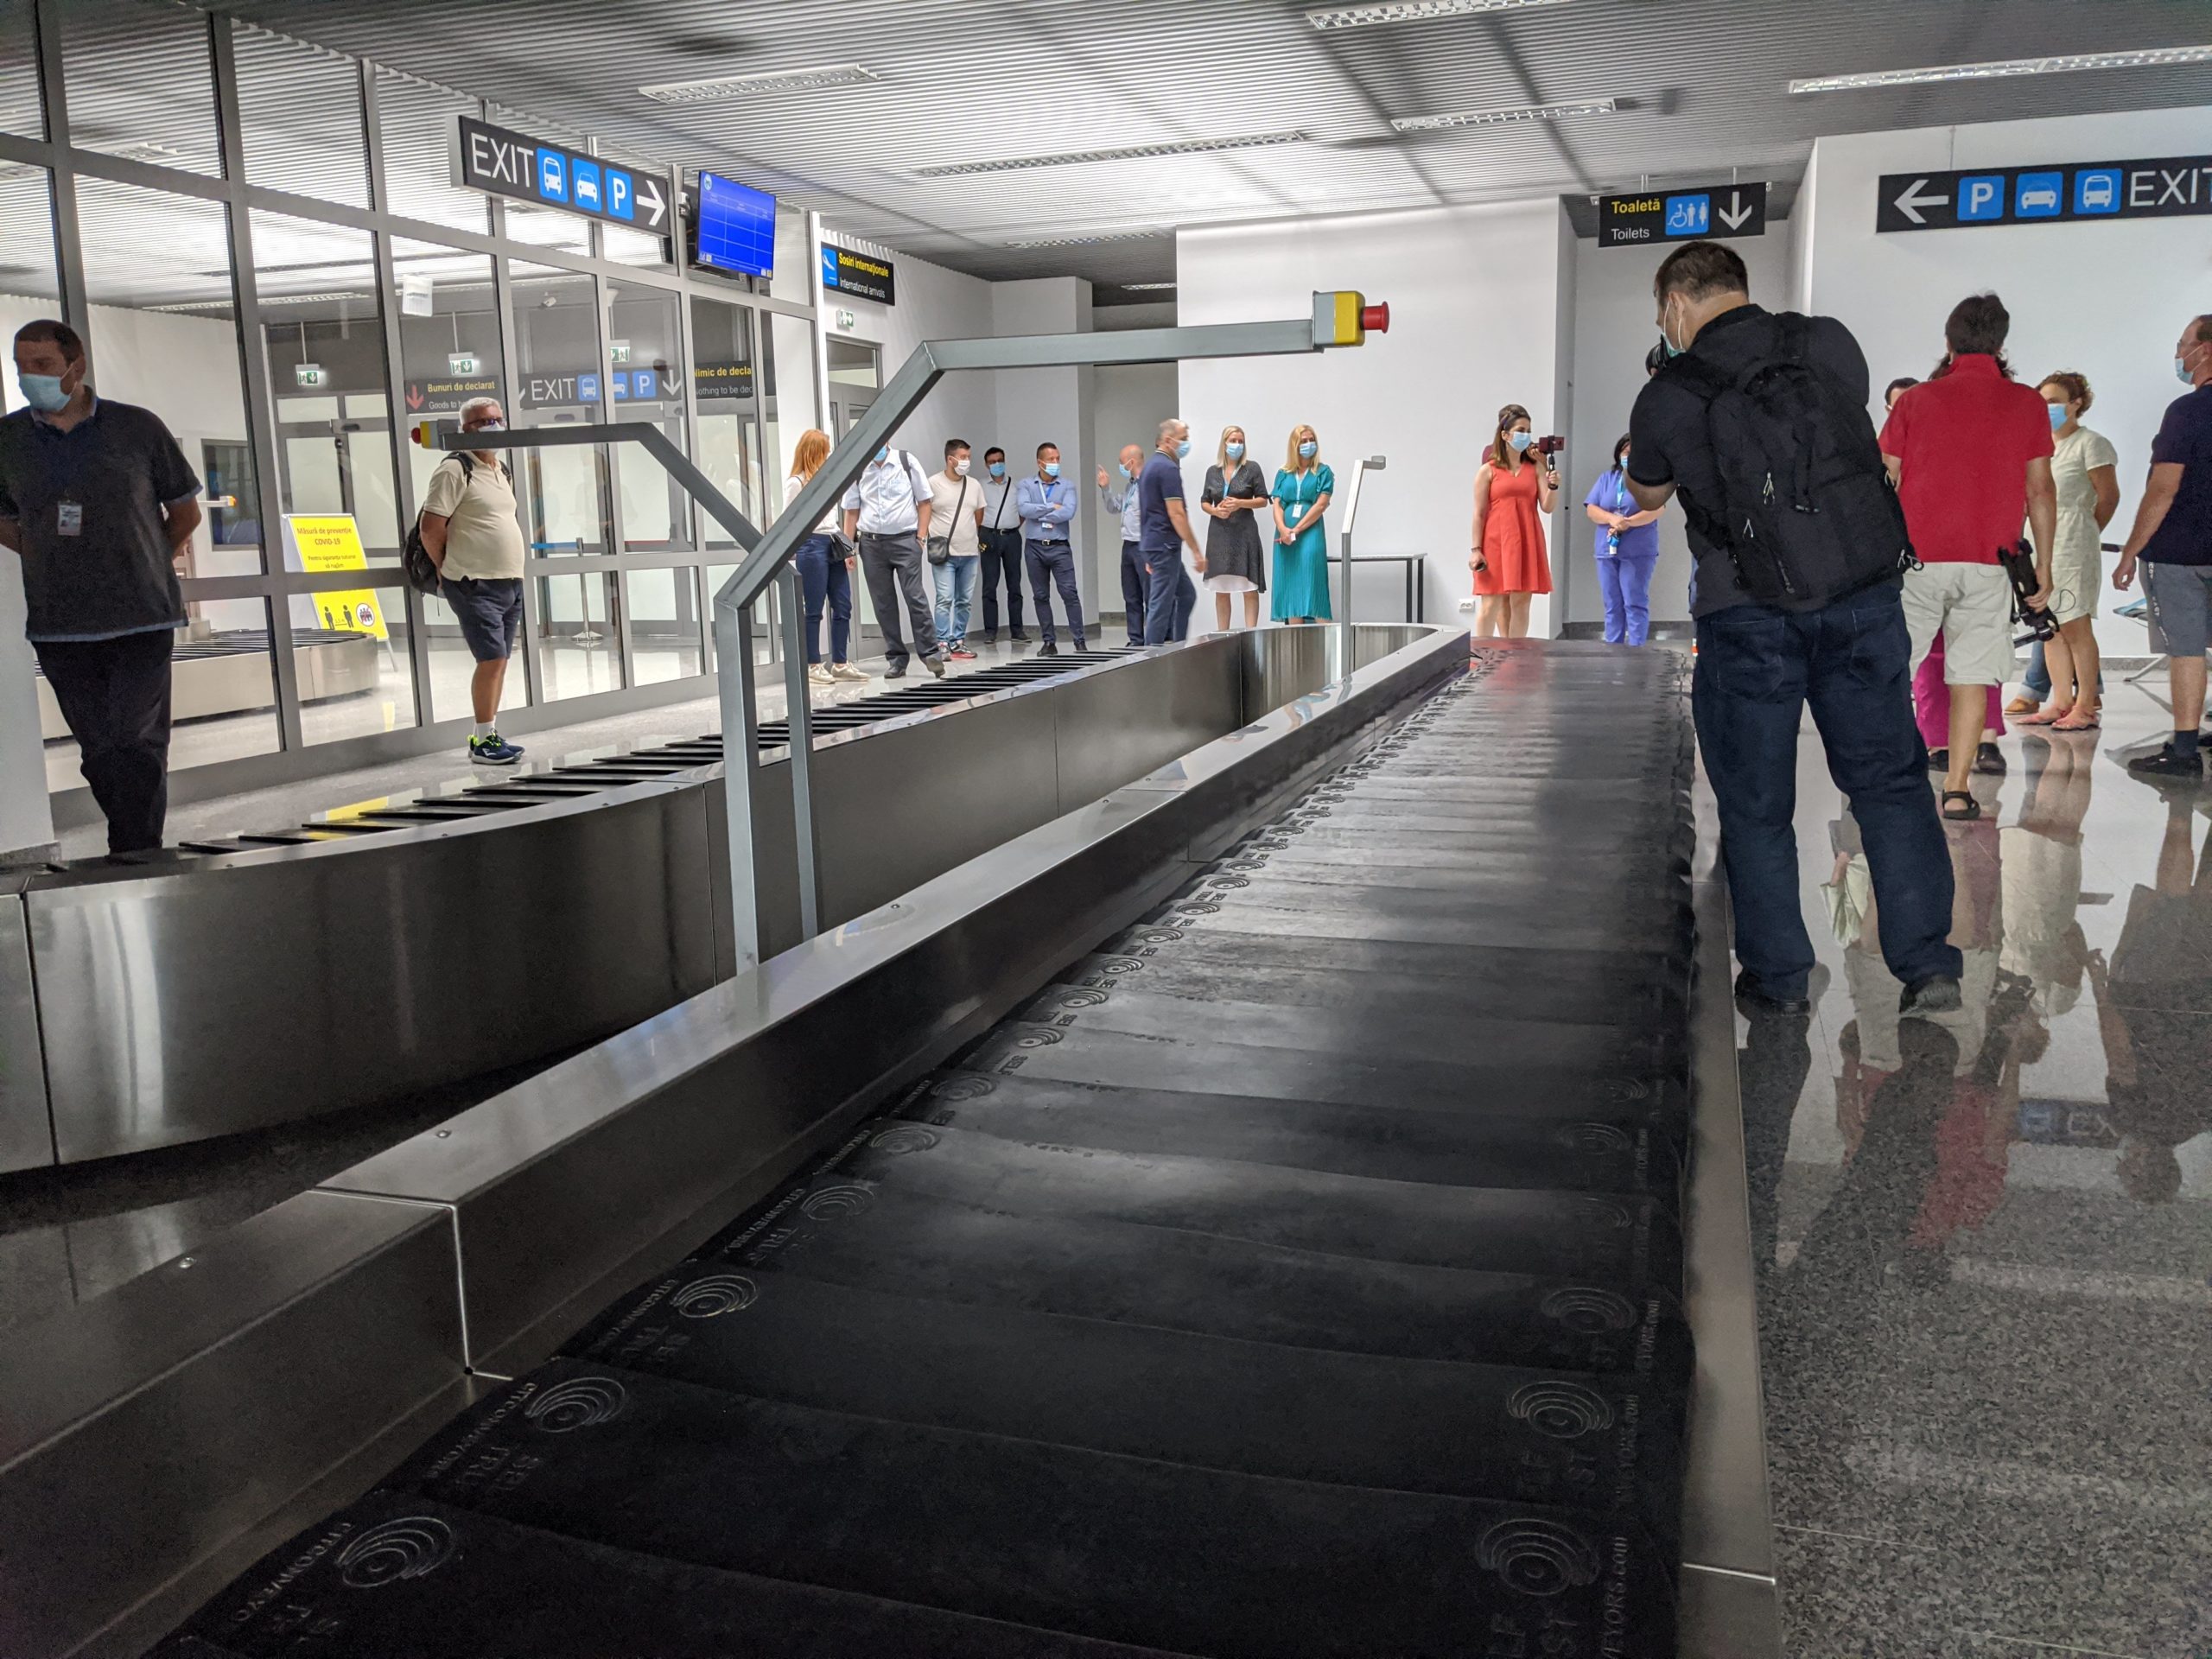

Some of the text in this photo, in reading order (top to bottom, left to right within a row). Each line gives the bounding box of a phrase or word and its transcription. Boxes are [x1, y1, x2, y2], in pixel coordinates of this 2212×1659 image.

[470, 132, 626, 210] EXIT P
[1970, 182, 1993, 214] P
[1611, 198, 1661, 214] Toaletă
[1611, 228, 1650, 241] Toilets
[838, 251, 855, 268] Sosiri
[839, 276, 886, 299] International arrivals
[716, 366, 728, 377] de
[728, 365, 752, 376] decla
[427, 379, 496, 393] Bunuri de declarat
[531, 375, 651, 401] EXIT P
[721, 386, 728, 395] to
[729, 385, 739, 394] be
[429, 400, 449, 410] Goods
[450, 400, 458, 409] to
[315, 537, 340, 546] COVID-19
